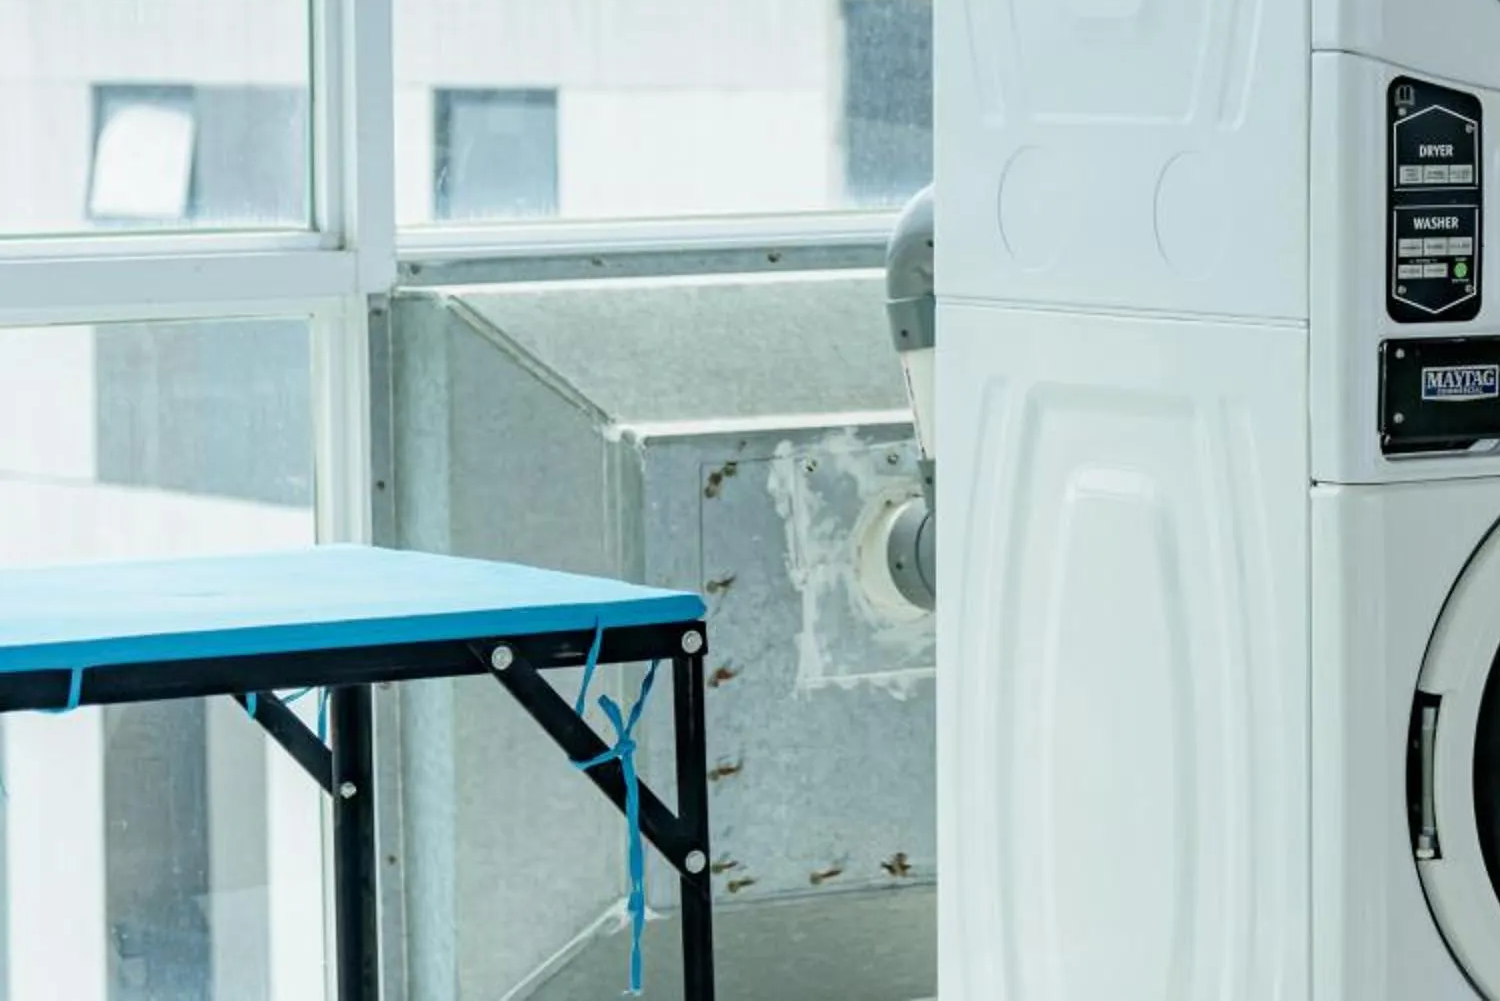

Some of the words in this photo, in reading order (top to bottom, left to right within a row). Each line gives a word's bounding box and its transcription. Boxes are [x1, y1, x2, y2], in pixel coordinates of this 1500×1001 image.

[1419, 144, 1453, 157] DRYER
[1413, 216, 1459, 230] WASHER
[1427, 370, 1494, 388] MAYTAG
